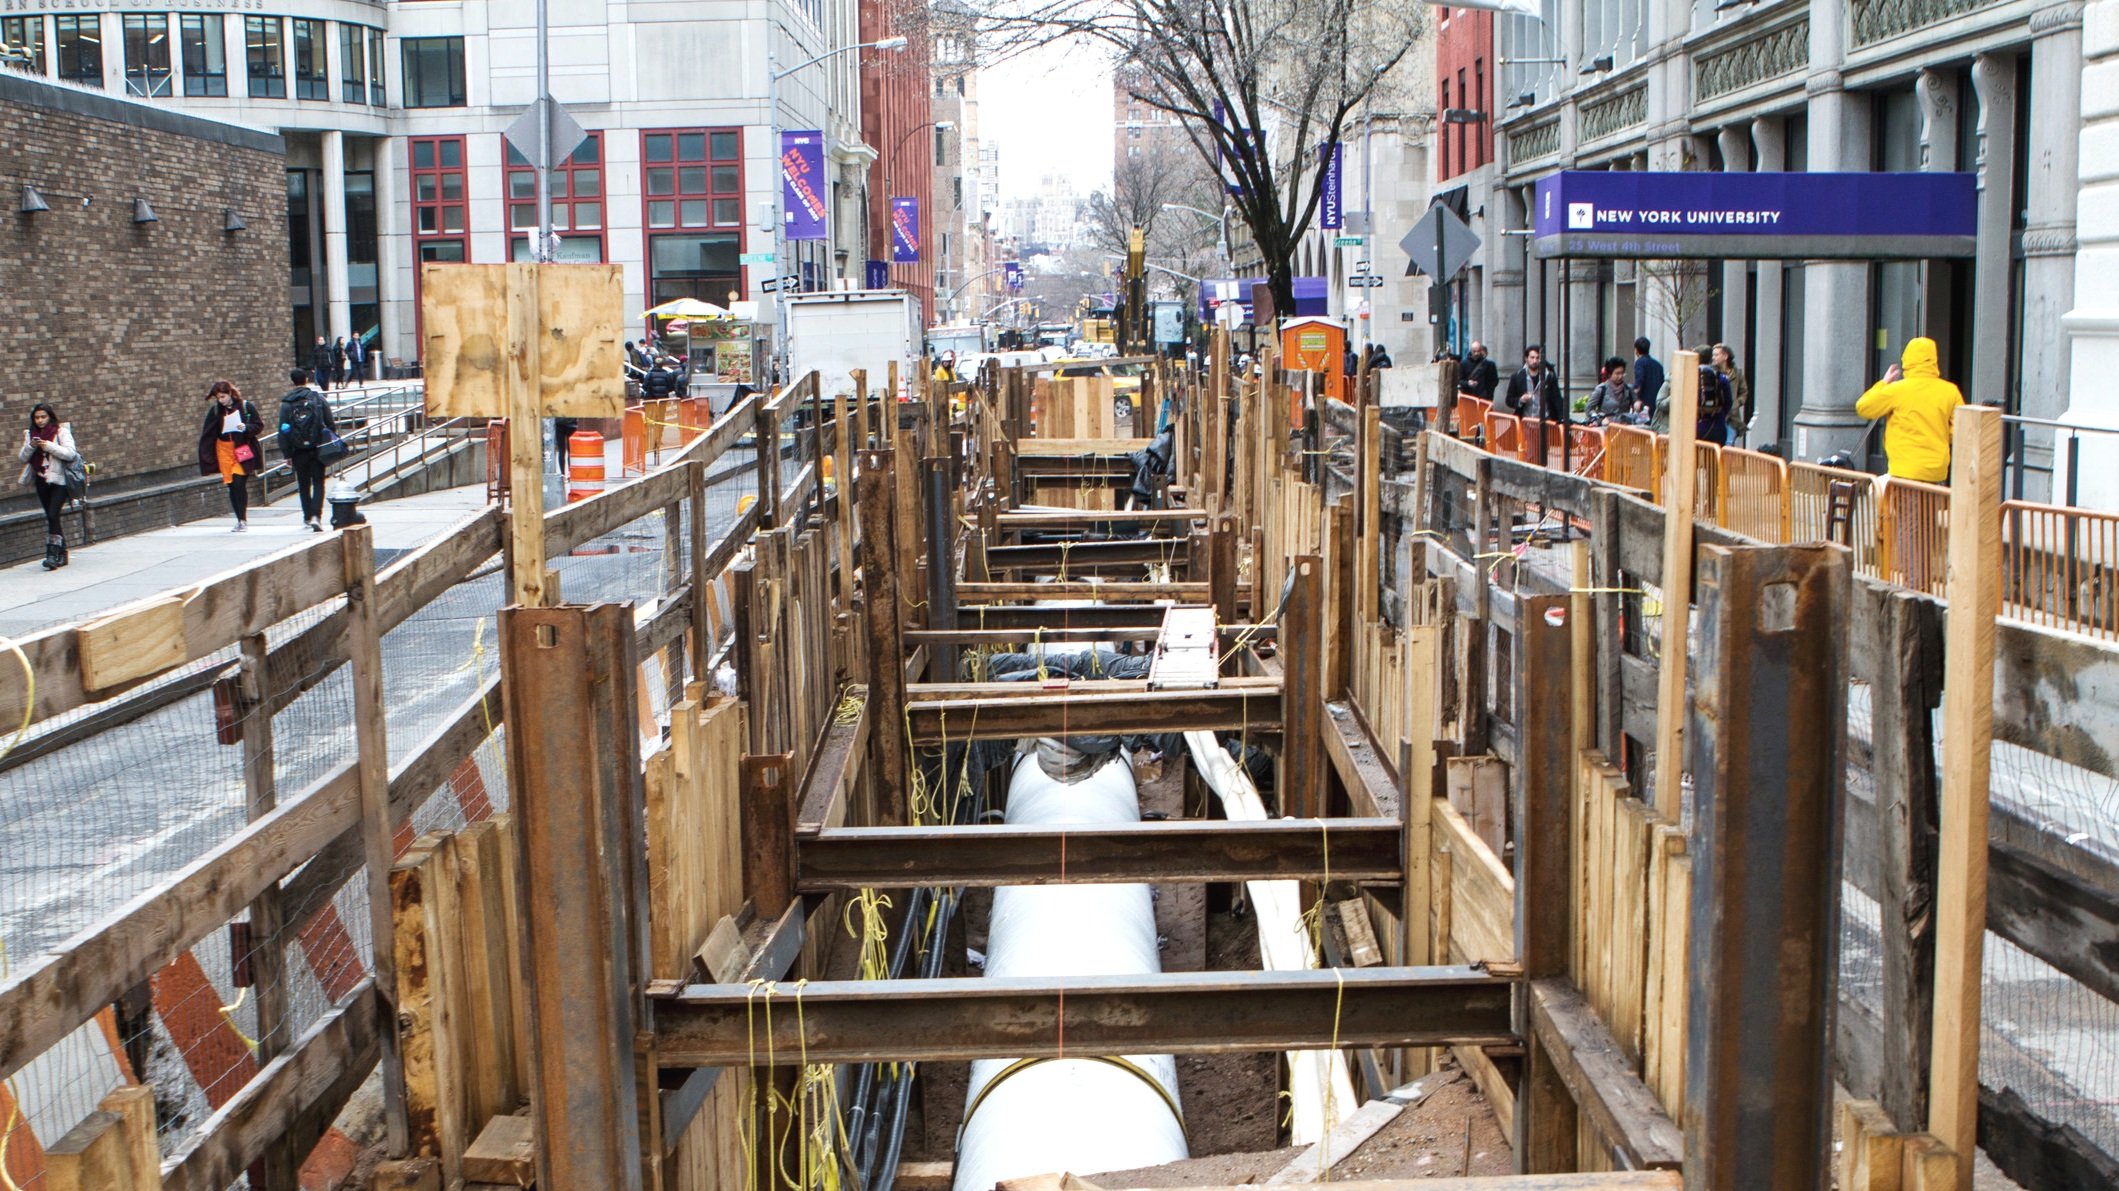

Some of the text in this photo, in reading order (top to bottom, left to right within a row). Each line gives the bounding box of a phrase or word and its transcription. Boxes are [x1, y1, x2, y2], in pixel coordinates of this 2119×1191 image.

[789, 148, 810, 174] NYU
[782, 154, 826, 218] WELCOMES
[1597, 210, 1780, 224] NEW YORK UNIVERSITY
[1569, 241, 1681, 254] 25 West 4th Street
